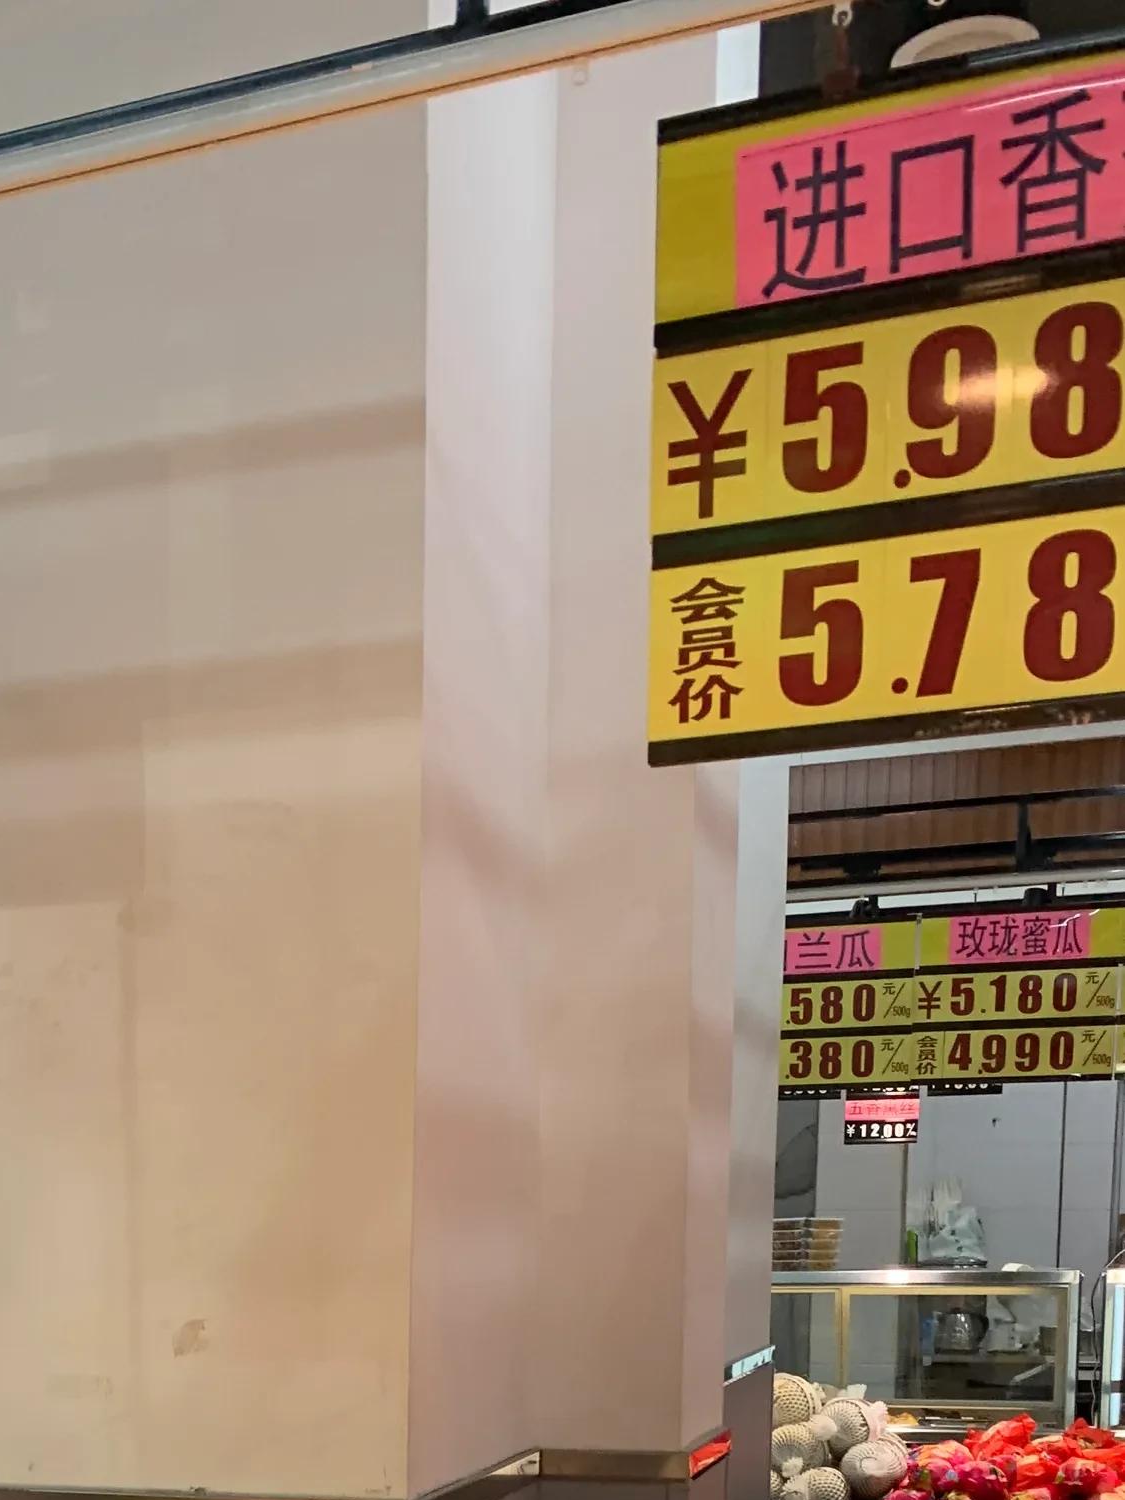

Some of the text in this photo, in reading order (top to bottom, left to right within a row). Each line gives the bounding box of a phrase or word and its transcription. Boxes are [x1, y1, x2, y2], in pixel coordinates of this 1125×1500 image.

[761, 88, 1125, 298] 进口香
[669, 576, 745, 724] 会员价
[783, 930, 875, 971] 兰瓜
[956, 916, 1083, 958] 玫珑蜜瓜
[915, 1035, 938, 1075] 会员价
[948, 1030, 1074, 1075] 4.990
